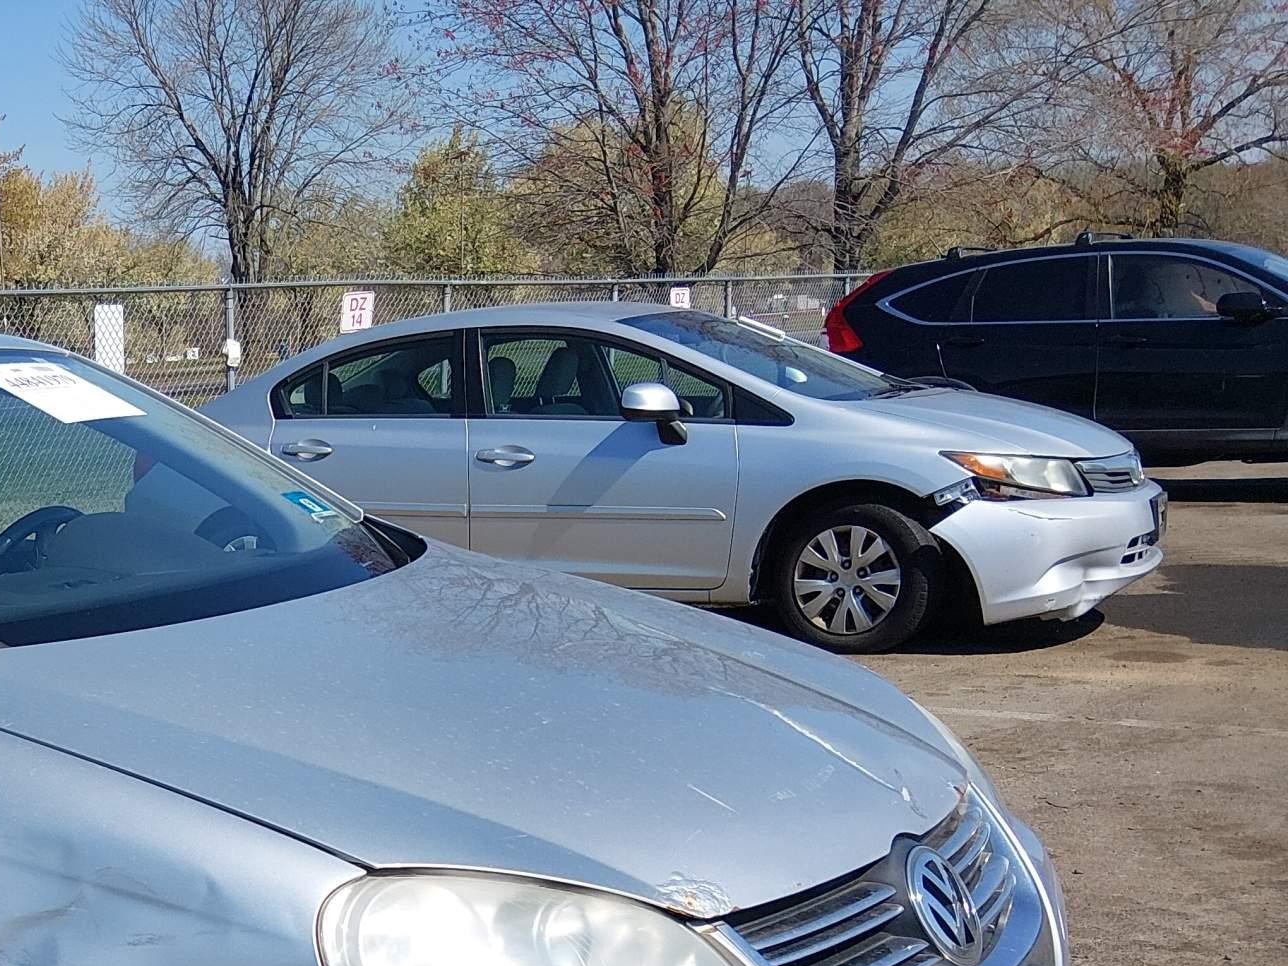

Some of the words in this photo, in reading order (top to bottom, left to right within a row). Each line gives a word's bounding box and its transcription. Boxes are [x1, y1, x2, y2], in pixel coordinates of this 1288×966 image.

[349, 296, 368, 312] DZ
[675, 292, 686, 304] DZ
[351, 312, 363, 328] 14
